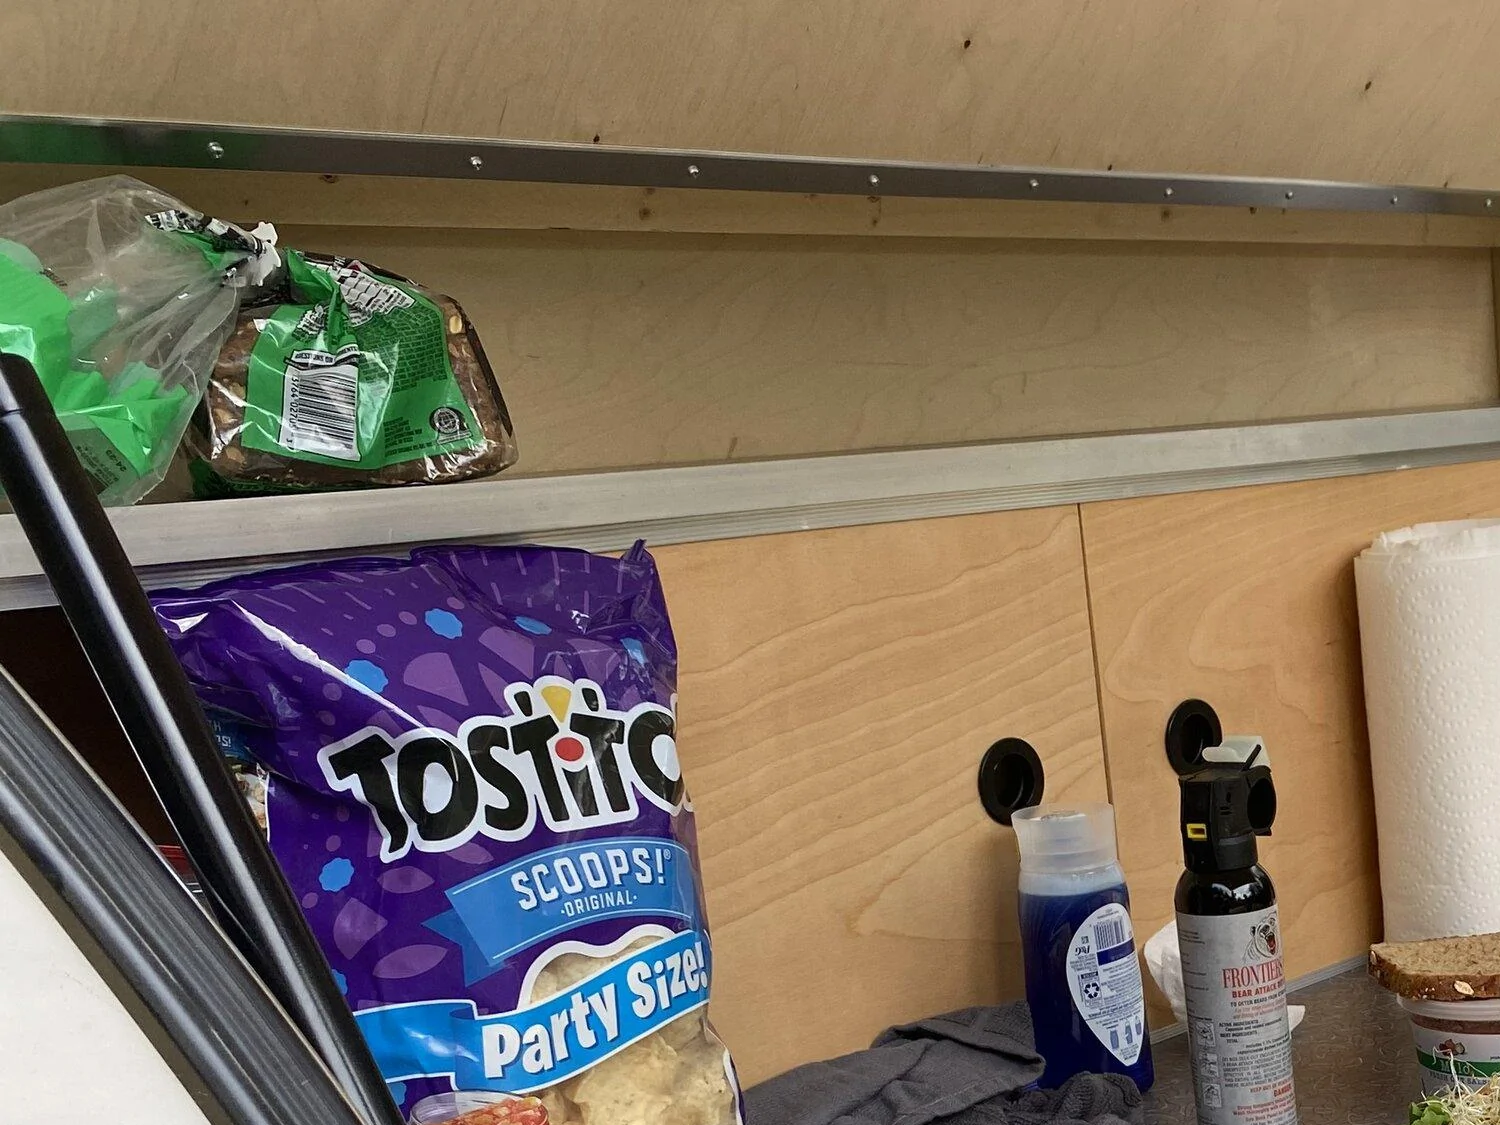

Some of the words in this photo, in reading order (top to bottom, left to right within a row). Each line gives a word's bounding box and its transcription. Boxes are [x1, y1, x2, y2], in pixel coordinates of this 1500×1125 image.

[328, 685, 685, 854] TOSTITO
[563, 889, 634, 918] ORIGINAL
[481, 982, 620, 1080] Party
[626, 940, 709, 1020] Size!
[1231, 989, 1253, 999] BEAR
[1254, 983, 1278, 996] ATTACK
